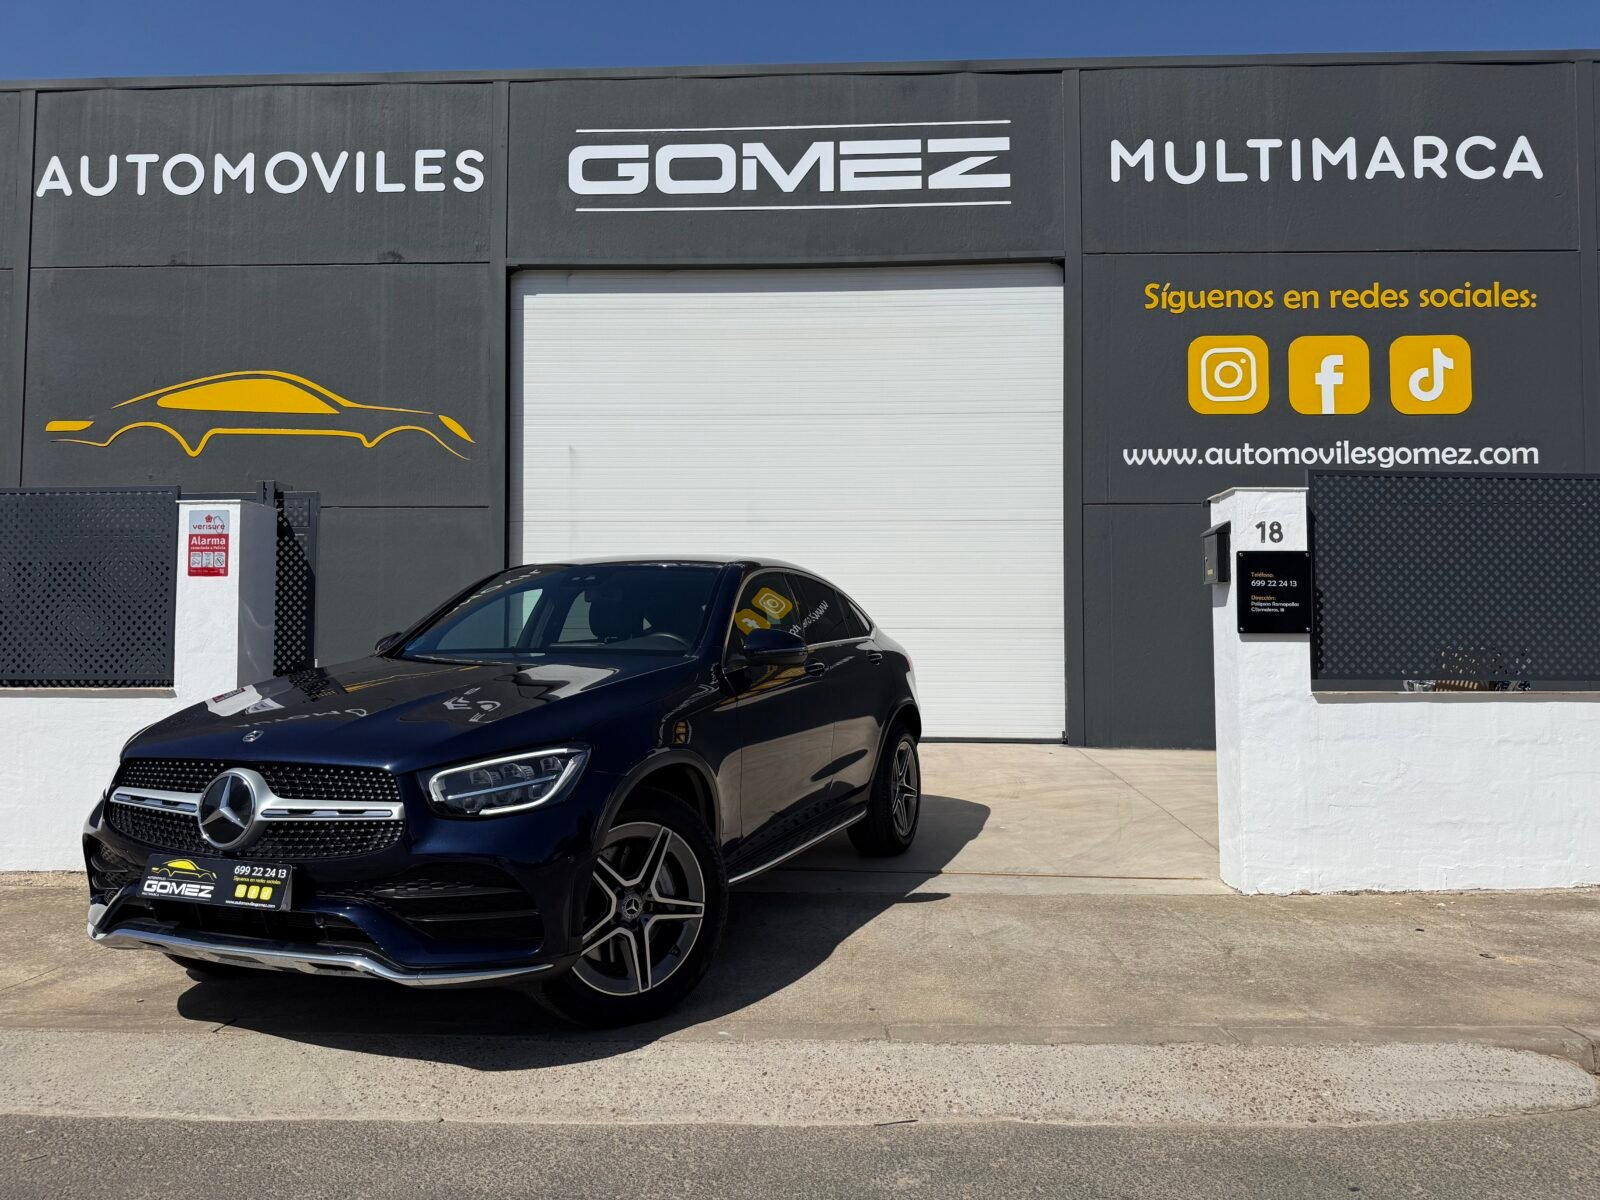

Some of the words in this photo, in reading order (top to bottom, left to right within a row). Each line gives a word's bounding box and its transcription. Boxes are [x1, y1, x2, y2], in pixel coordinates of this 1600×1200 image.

[36, 149, 485, 197] AUTOMOVILES
[568, 137, 1011, 195] GOMEZ
[1110, 135, 1544, 185] MULTIMARCA
[1144, 282, 1274, 314] Síguenos
[1283, 289, 1319, 310] en
[1329, 282, 1409, 309] redes
[1419, 281, 1537, 308] sociales:
[1122, 440, 1539, 469] www.automovilesgomez.com
[191, 536, 226, 545] Alarma
[1255, 521, 1284, 543] 18
[234, 865, 251, 876] 699
[252, 866, 264, 877] 22
[264, 868, 276, 878] 24
[277, 869, 287, 879] 13
[143, 880, 215, 899] GOMEZ
